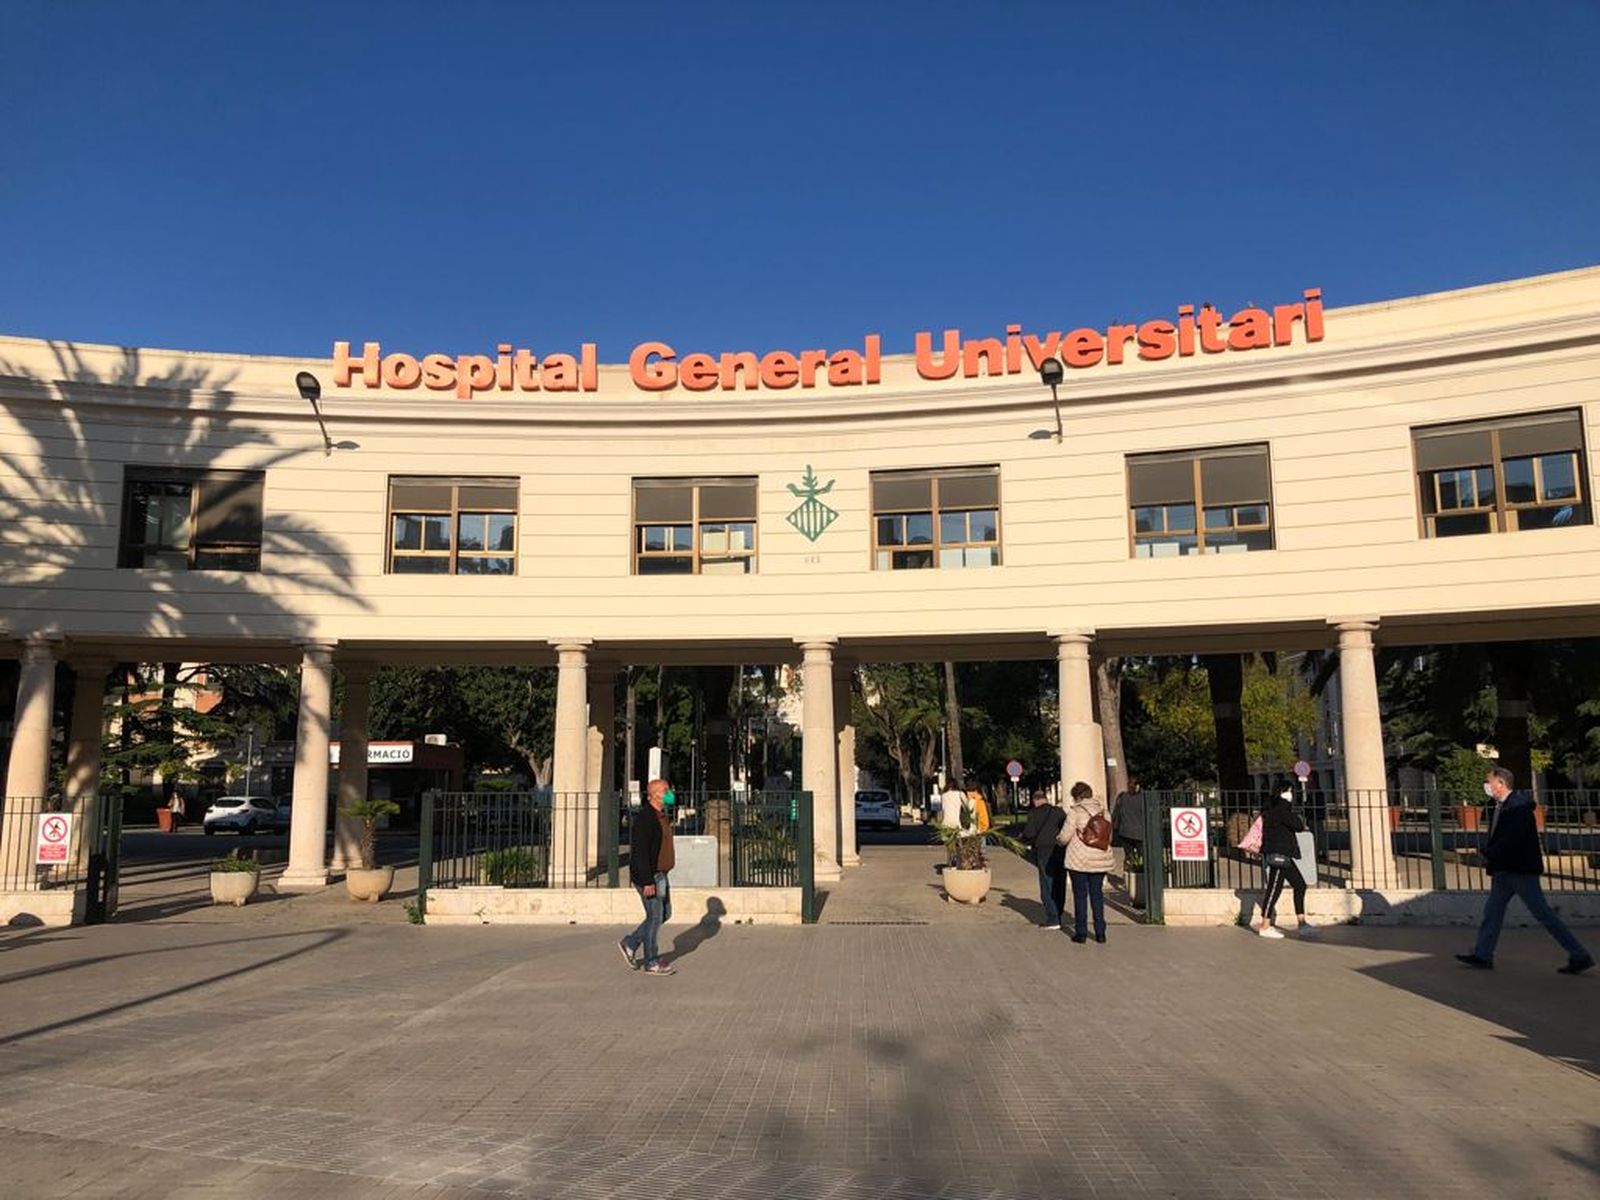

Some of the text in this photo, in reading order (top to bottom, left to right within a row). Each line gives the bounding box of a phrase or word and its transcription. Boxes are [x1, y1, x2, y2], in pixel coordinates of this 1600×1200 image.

[333, 288, 1325, 400] Hospital General Universitari
